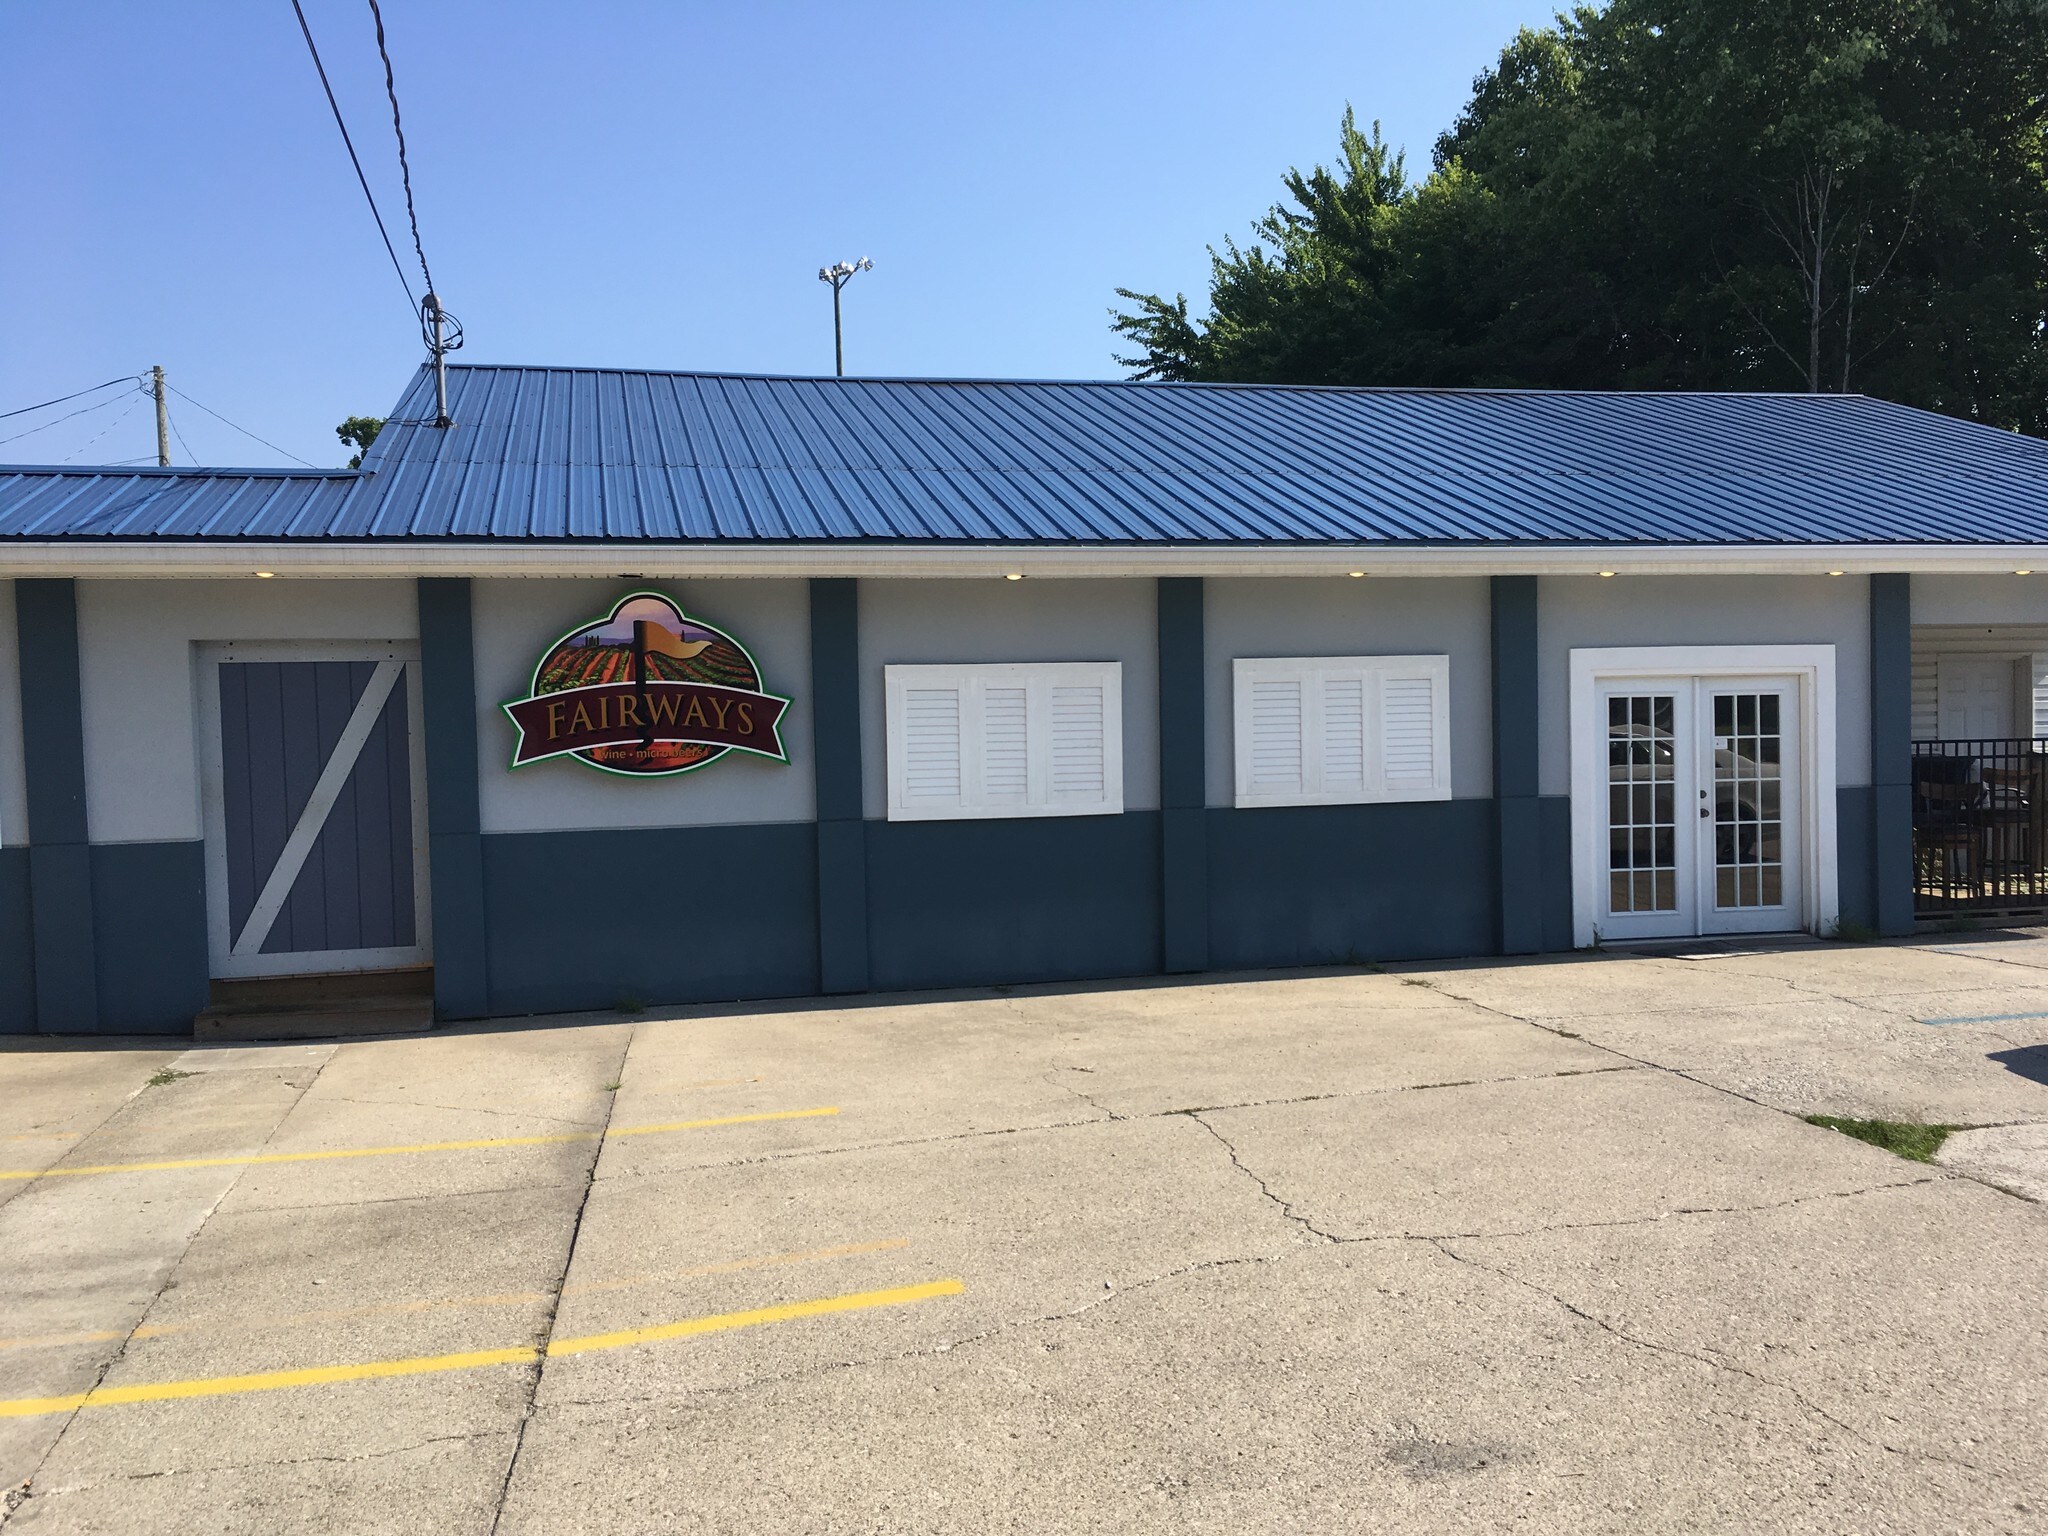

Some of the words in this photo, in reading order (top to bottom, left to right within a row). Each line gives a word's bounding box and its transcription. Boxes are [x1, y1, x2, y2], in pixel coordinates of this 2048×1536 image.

[546, 693, 755, 741] FAIRWAYS
[600, 749, 627, 760] wine
[636, 748, 669, 759] micro
